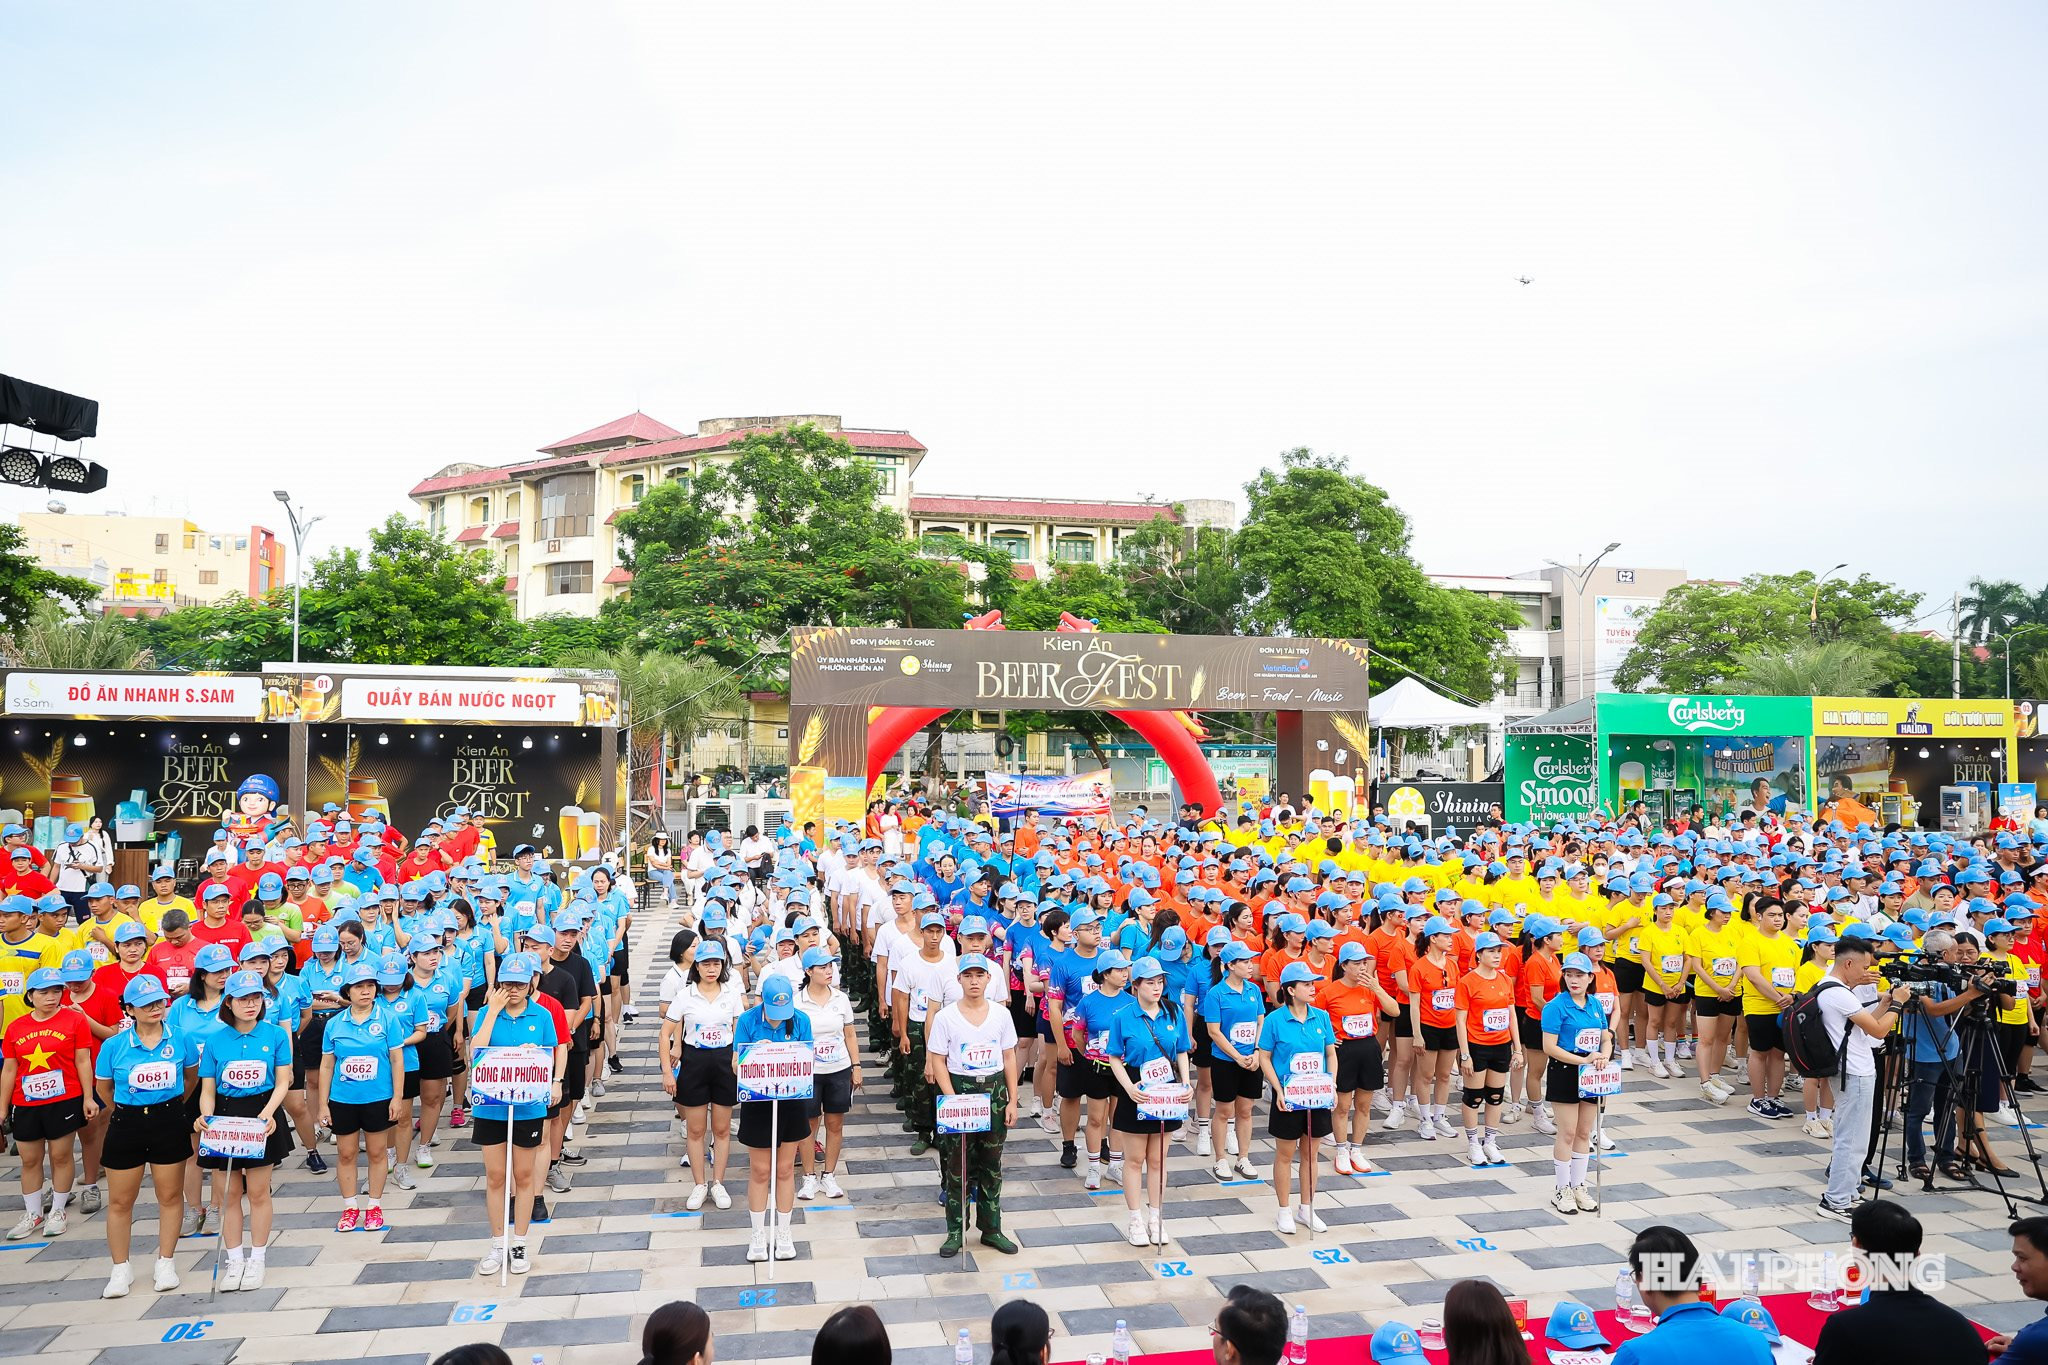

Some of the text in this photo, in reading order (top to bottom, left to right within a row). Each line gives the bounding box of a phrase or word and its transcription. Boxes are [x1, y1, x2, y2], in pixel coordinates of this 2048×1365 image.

[1618, 571, 1633, 582] C2
[850, 637, 867, 646] ĐƠN
[869, 638, 877, 647] VỊ
[1043, 636, 1112, 651] Kien An
[318, 679, 328, 689] 01
[975, 650, 1182, 707] BEER FEST
[68, 681, 234, 704] ĐỒ ĂN NHANH S.SAM
[366, 686, 556, 712] QUẦY BÁN NƯỚC NGỌT
[1216, 686, 1247, 701] Beer
[1262, 687, 1294, 703] Food
[1307, 688, 1344, 703] Music
[13, 697, 50, 708] S.Sam
[1667, 697, 1745, 730] Carlsberg
[1823, 709, 1888, 726] BIA TƯƠI NGON
[1900, 723, 1928, 734] HALIDA
[168, 742, 223, 754] Kien An
[456, 745, 509, 757] Kien An
[1751, 742, 1774, 759] NGON
[1955, 753, 1989, 763] Kien An
[162, 755, 231, 783] BEER
[451, 758, 516, 785] BEER
[1953, 763, 1993, 784] BEER
[149, 780, 238, 823] FEST
[39, 1028, 52, 1038] VIỆT
[1347, 1020, 1369, 1031] 0764
[1578, 1036, 1600, 1046] 0819
[813, 1045, 835, 1056] 1457
[967, 1049, 992, 1061] 1777
[345, 1063, 372, 1074] 0662
[475, 1062, 548, 1083] CÔNG AN PHƯỜNG
[766, 1063, 775, 1078] TH
[802, 1061, 812, 1076] DU
[1146, 1065, 1169, 1079] 1636
[1295, 1060, 1319, 1071] 1819
[137, 1070, 169, 1084] 0681
[228, 1069, 260, 1081] 0655
[27, 1079, 57, 1093] 1552
[980, 1106, 989, 1117] 653
[1456, 1237, 1498, 1252] 24
[1309, 1248, 1350, 1264] 25
[1153, 1261, 1194, 1278] 26
[1001, 1272, 1037, 1291] 27
[738, 1288, 778, 1308] 28
[452, 1303, 497, 1324] 29
[160, 1319, 214, 1344] 30
